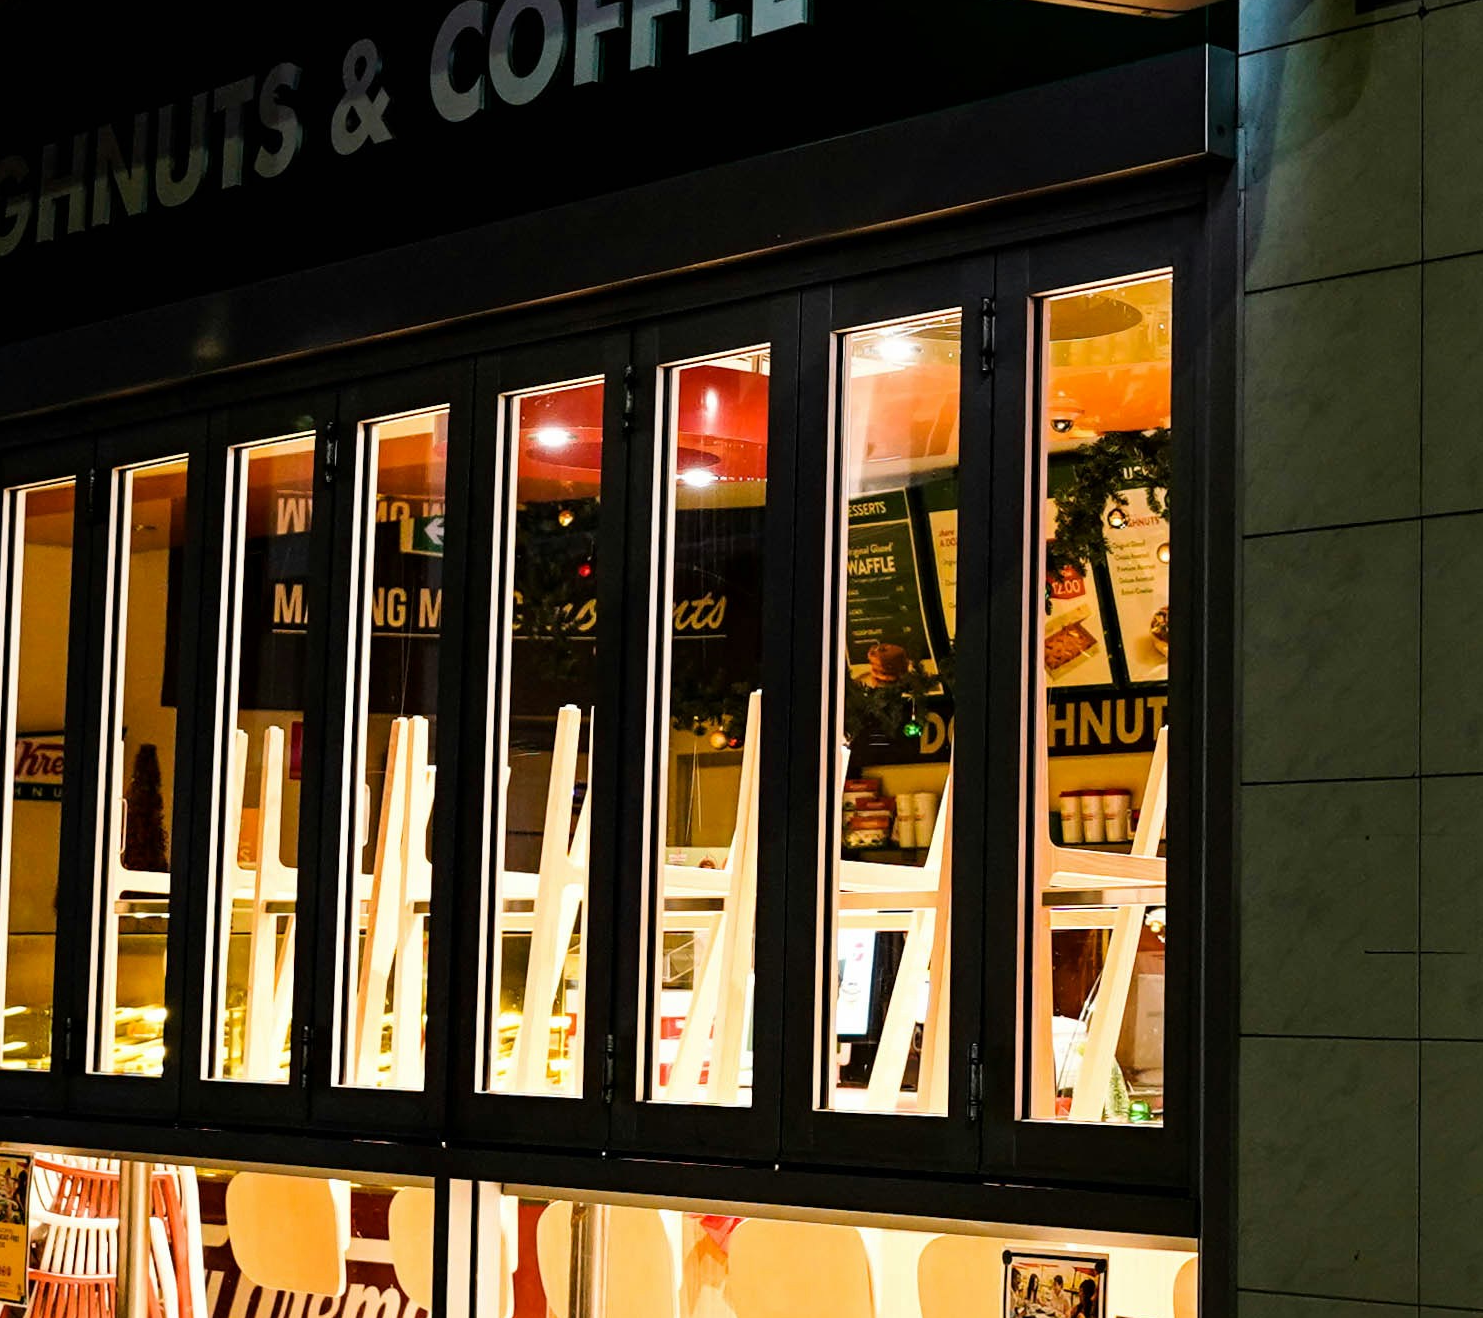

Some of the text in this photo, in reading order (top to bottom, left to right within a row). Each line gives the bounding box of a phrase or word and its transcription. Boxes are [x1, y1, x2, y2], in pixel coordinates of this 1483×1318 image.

[330, 36, 393, 157] &
[848, 501, 888, 517] ESSERTS
[847, 555, 897, 577] WAFFLE
